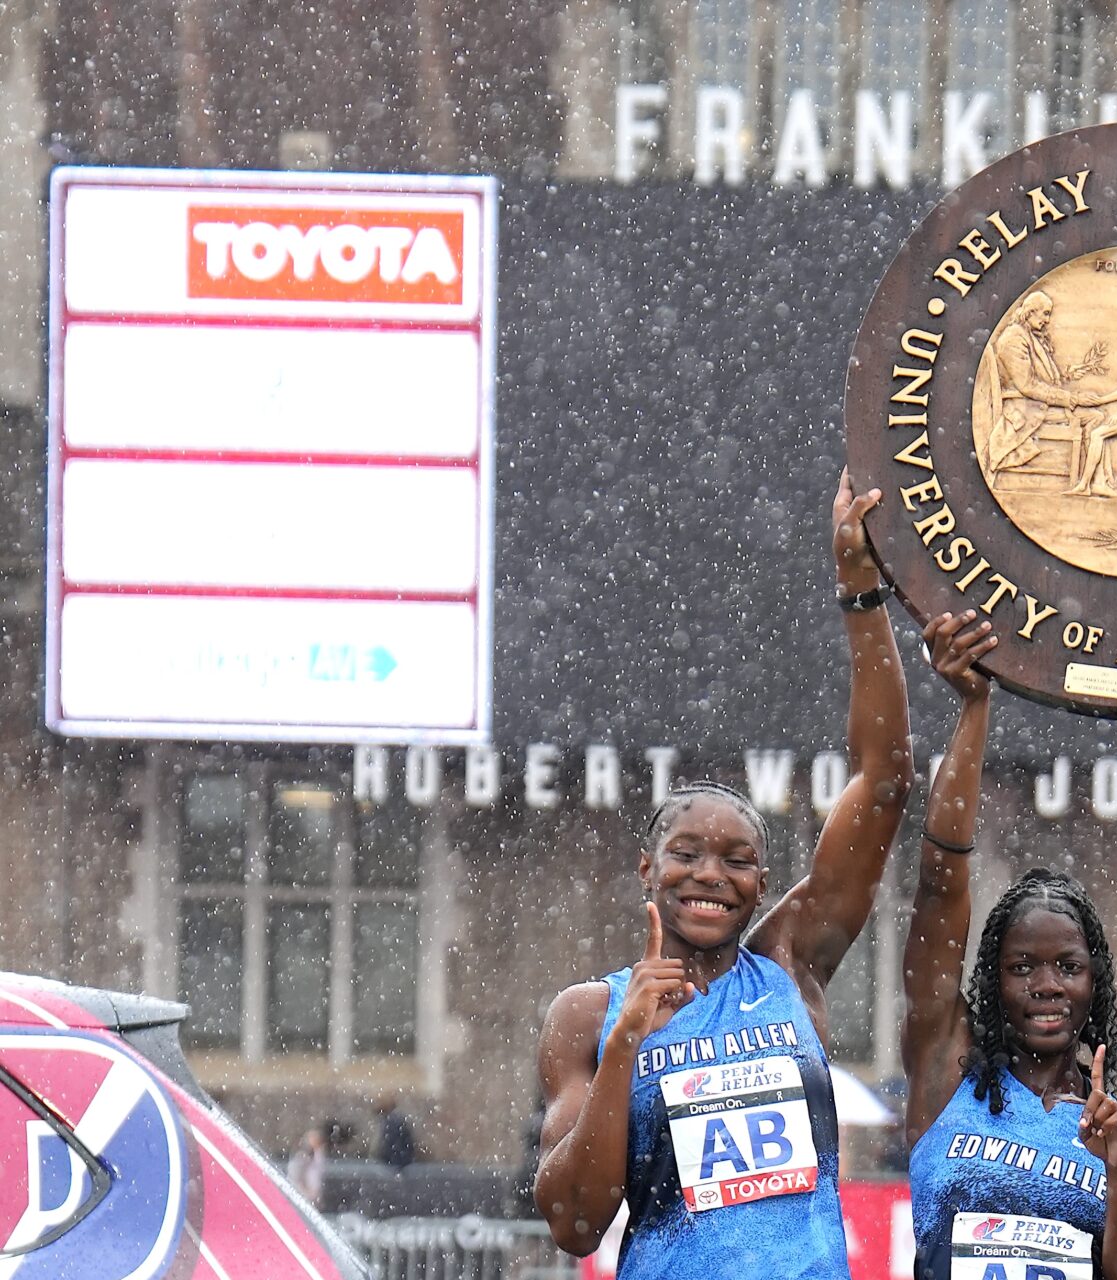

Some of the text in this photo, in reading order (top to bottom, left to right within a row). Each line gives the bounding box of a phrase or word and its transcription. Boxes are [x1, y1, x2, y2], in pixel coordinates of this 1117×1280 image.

[193, 222, 458, 284] TOYOTA
[934, 169, 1092, 298] RELAY
[888, 326, 1058, 643] UNIVERSITY
[1062, 621, 1104, 655] OF
[353, 744, 682, 807] ROBERT
[637, 1020, 798, 1079] EDWIN ALLEN
[720, 1062, 766, 1080] PENN
[721, 1072, 783, 1092] RELAYS
[689, 1098, 746, 1115] Dream On.
[700, 1110, 794, 1180] AB
[946, 1132, 1108, 1201] EDWIN ALLE
[725, 1172, 810, 1200] TOYOTA
[1011, 1232, 1075, 1250] RELAYS
[1013, 1219, 1063, 1235] PENN
[973, 1245, 1031, 1257] Dream On.
